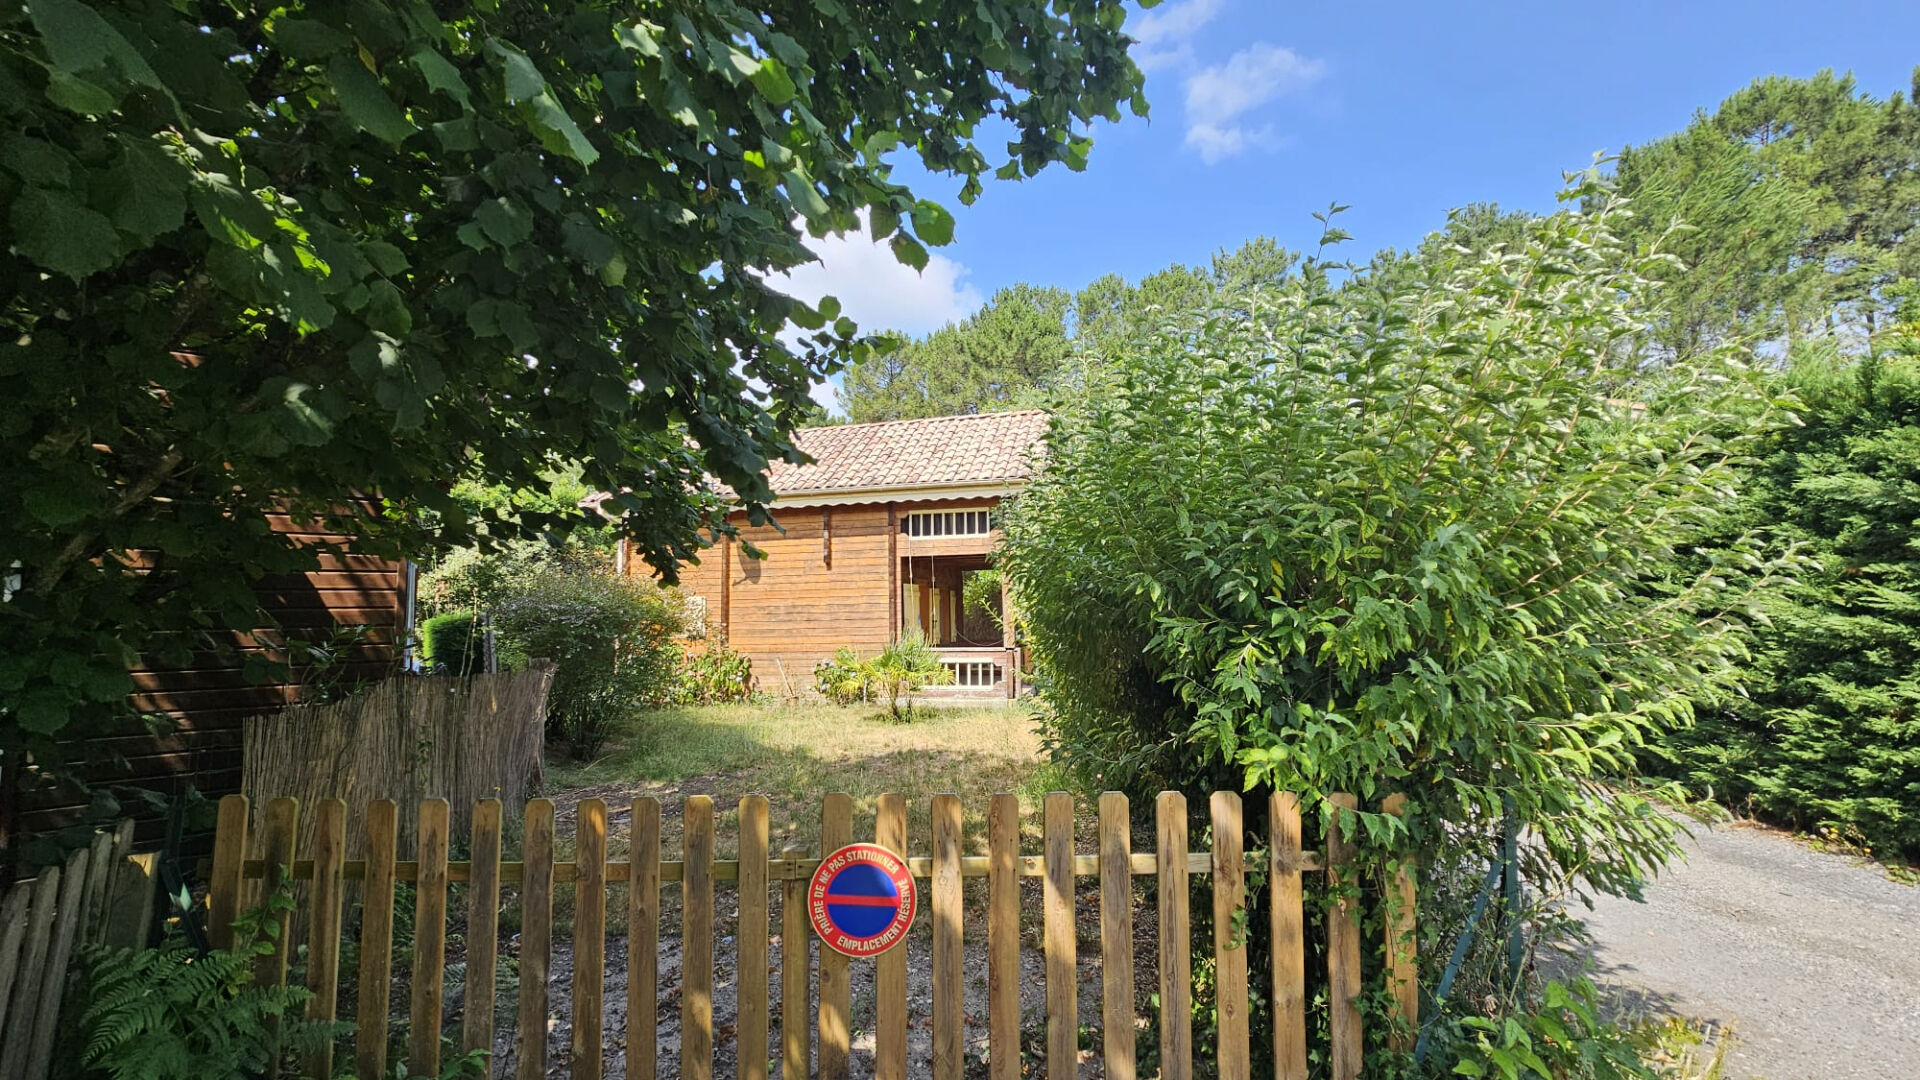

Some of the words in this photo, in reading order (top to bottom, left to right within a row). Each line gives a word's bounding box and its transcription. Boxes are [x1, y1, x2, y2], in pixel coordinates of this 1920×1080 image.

[828, 855, 846, 872] PAS
[846, 850, 899, 875] STATIONNER
[819, 870, 831, 884] NE
[814, 884, 825, 898] DE
[814, 900, 834, 935] PRIÈRE
[837, 921, 903, 951] EMPLACEMENT
